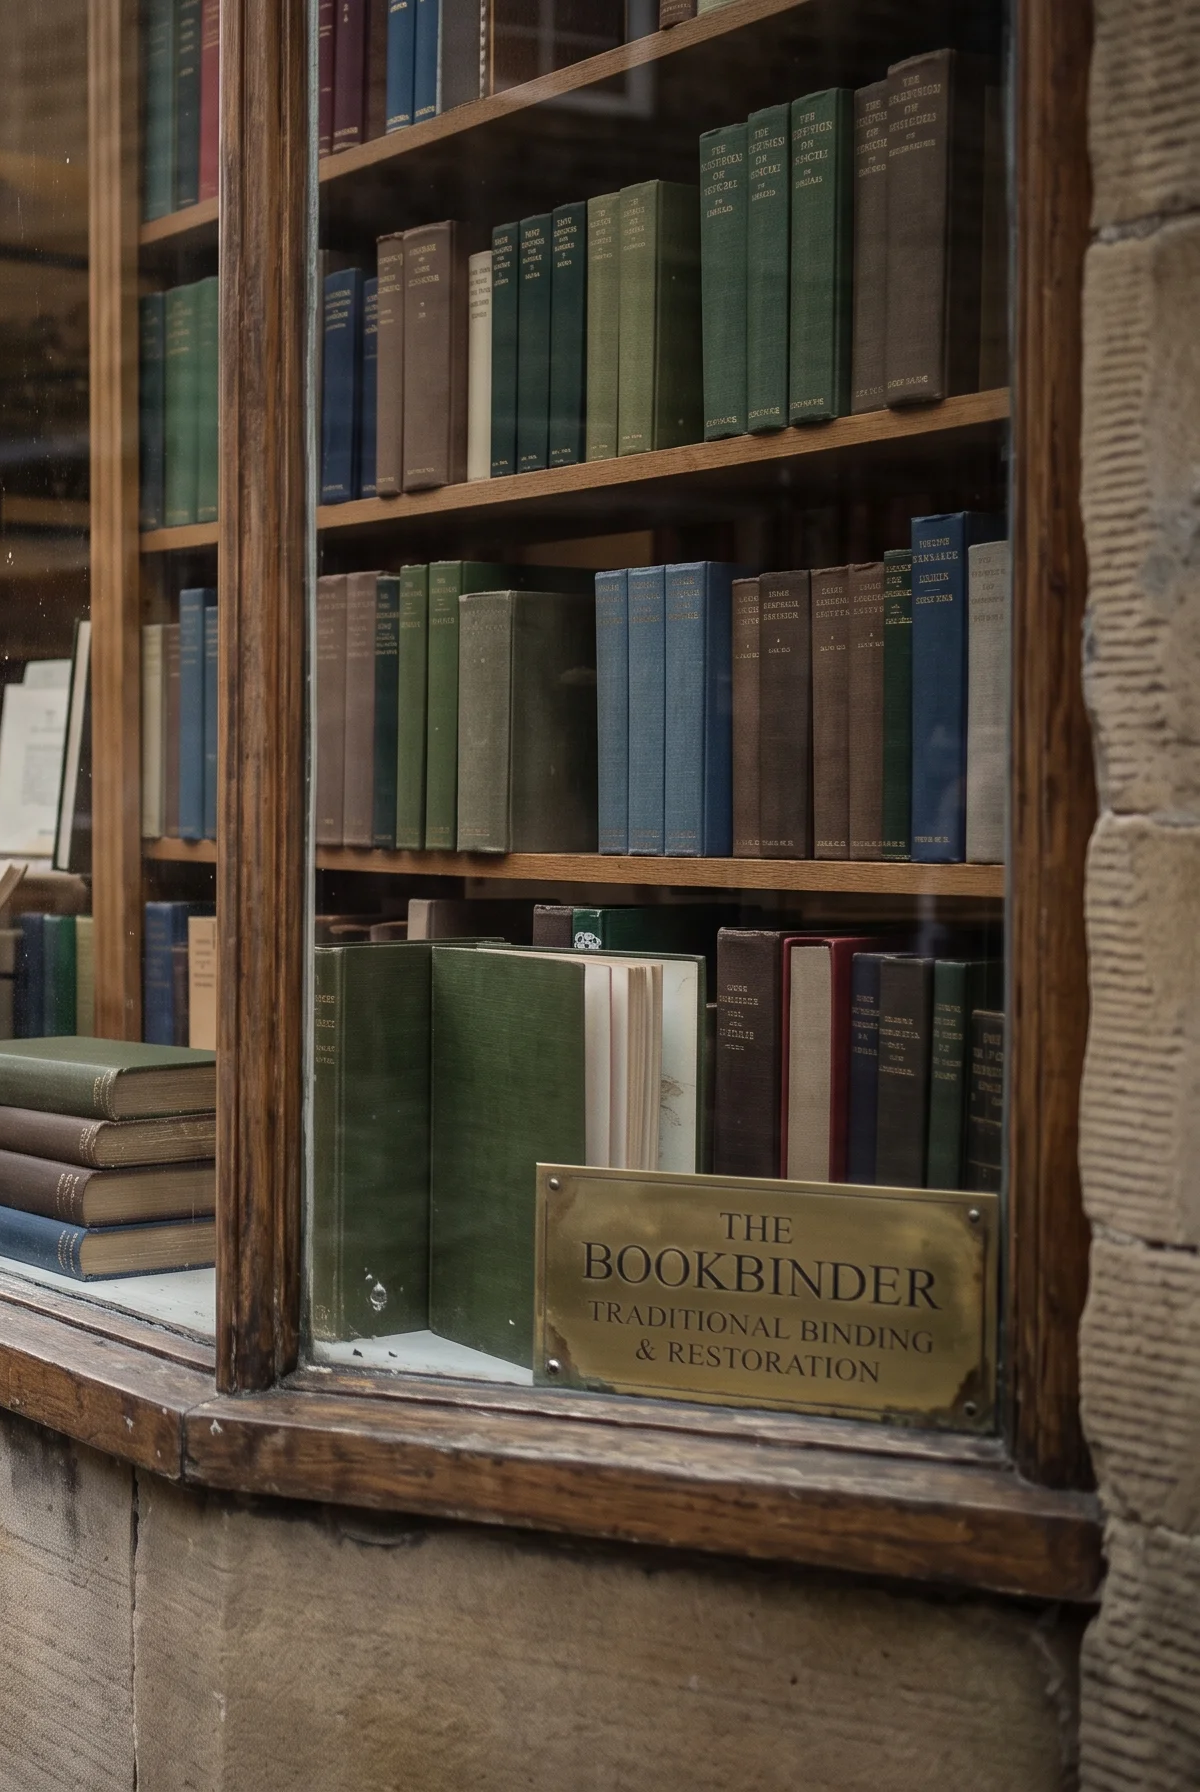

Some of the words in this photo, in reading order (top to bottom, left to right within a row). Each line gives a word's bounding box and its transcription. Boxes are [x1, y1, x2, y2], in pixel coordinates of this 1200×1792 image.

[719, 1212, 793, 1244] THE
[582, 1241, 942, 1310] BOOKBINDER
[588, 1300, 791, 1340] TRADITIONAL
[800, 1319, 934, 1355] BINDING
[635, 1338, 657, 1362] &
[668, 1342, 881, 1384] RESTORATION
